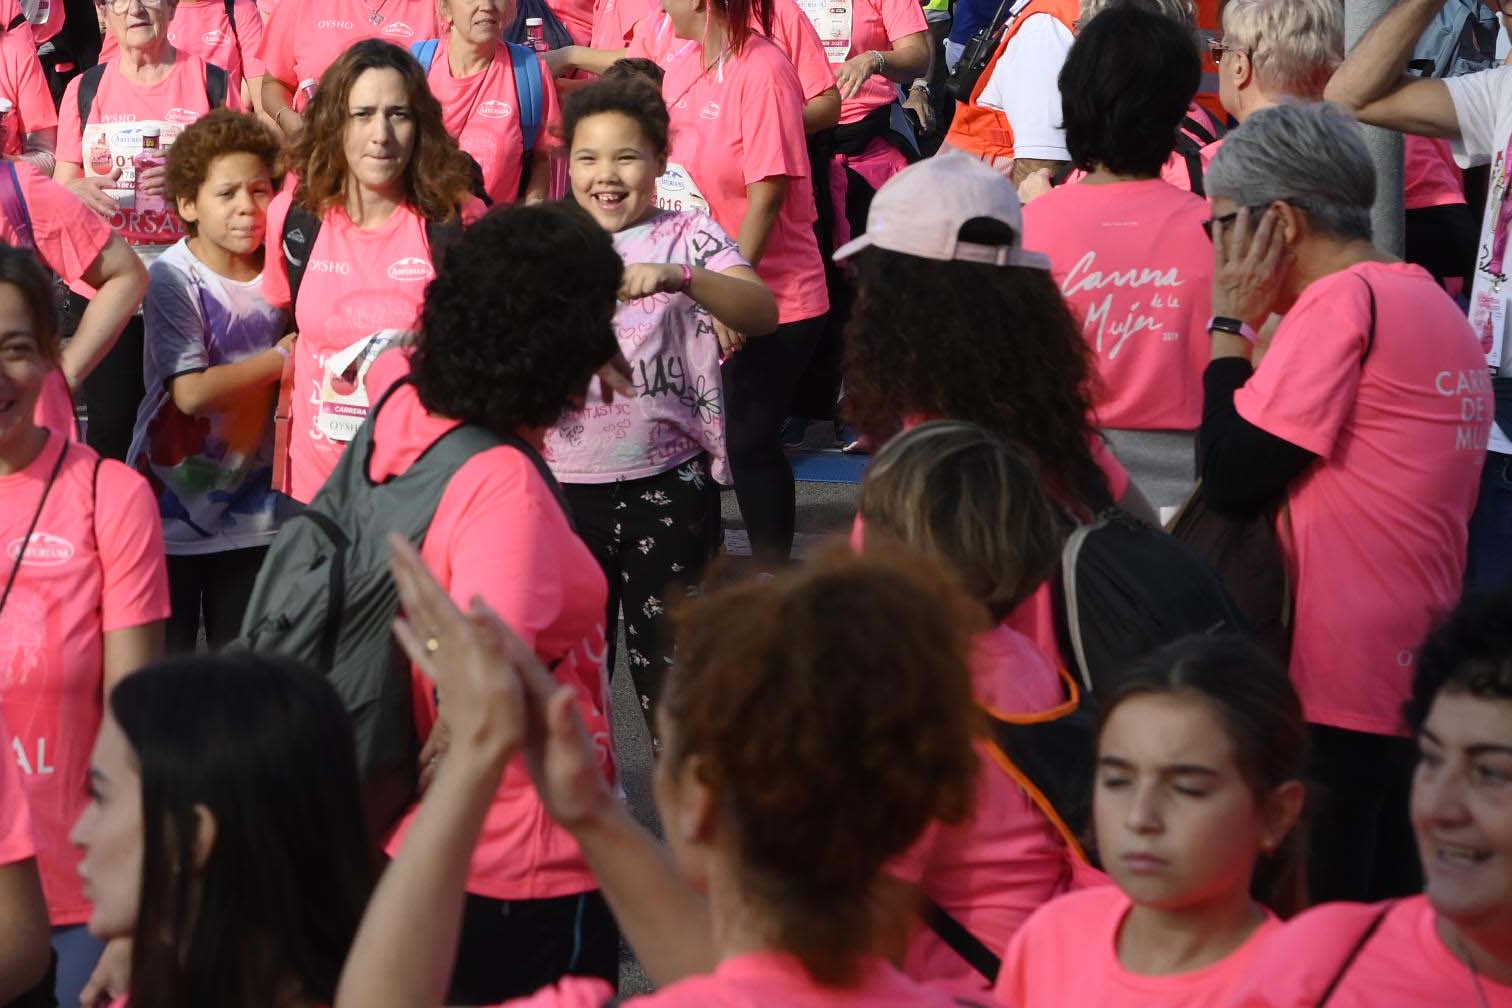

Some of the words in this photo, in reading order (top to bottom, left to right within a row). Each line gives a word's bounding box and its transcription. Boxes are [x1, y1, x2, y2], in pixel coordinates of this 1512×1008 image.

[116, 155, 136, 169] 01
[659, 199, 682, 212] 016
[1083, 293, 1163, 360] Mujer
[335, 405, 367, 415] CARRERA
[12, 736, 54, 774] AL
